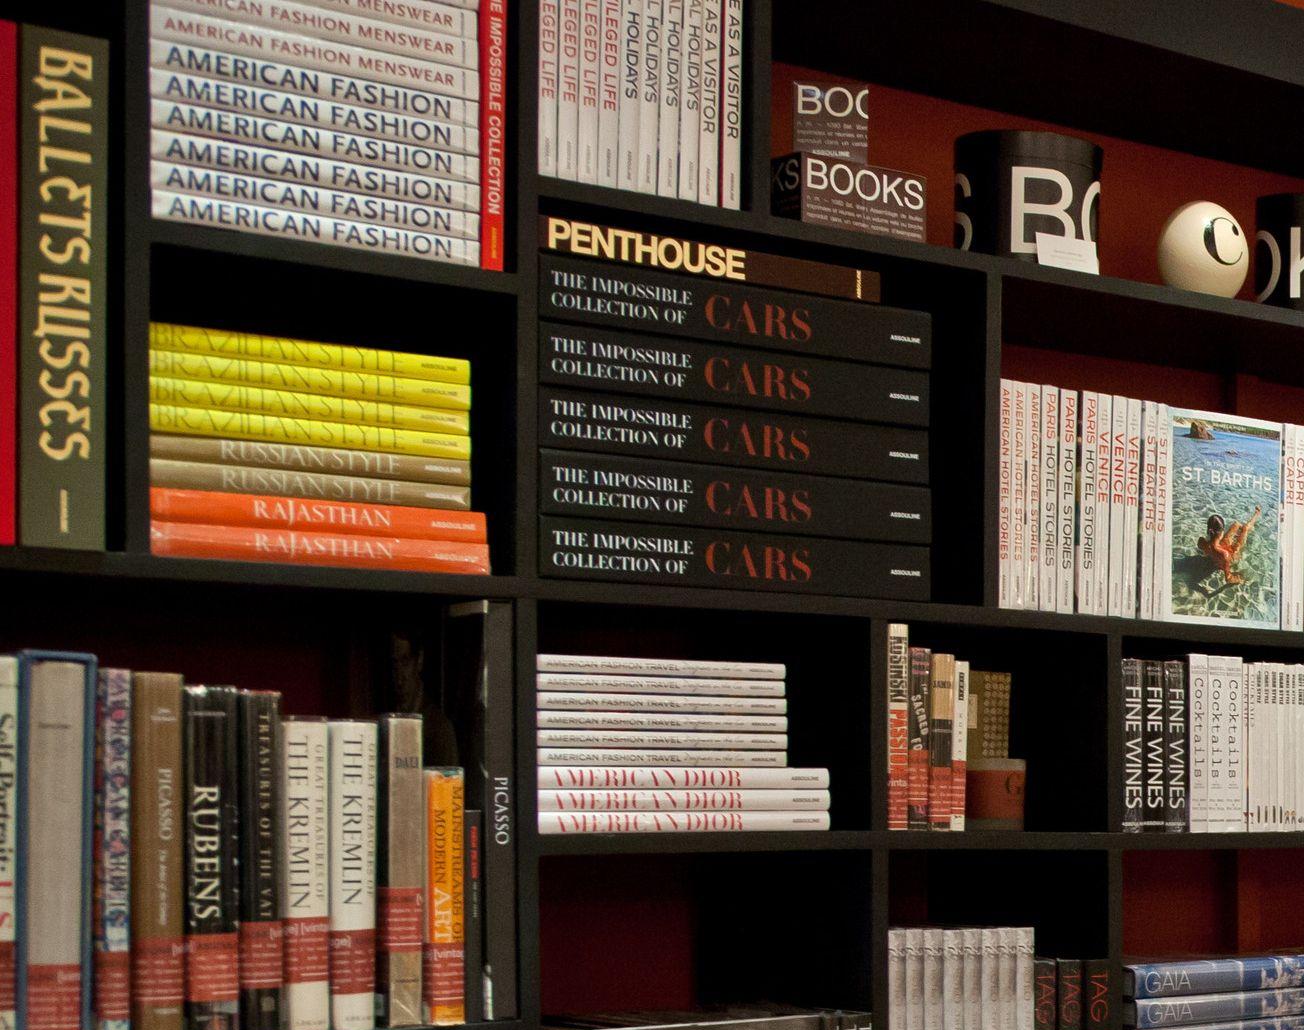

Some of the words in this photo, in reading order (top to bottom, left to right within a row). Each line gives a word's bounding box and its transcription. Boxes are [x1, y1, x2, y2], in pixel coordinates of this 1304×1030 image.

[164, 17, 263, 50] AMERICAN
[270, 38, 350, 66] FASHION
[358, 56, 455, 87] MENSWEAR
[728, 15, 741, 40] AS
[728, 45, 740, 58] A
[489, 15, 504, 111] IMPOSSIBLE
[624, 11, 640, 100] HOLIDAYS
[166, 46, 320, 95] AMERICAN
[331, 76, 452, 119] FASHION
[603, 73, 617, 112] LIFE
[726, 64, 741, 140] VISITOR
[34, 46, 93, 266] BALLETS
[487, 116, 502, 215] COLLECTION
[806, 157, 924, 211] BOOKS
[168, 196, 321, 239] AMERICAN
[548, 217, 747, 281] PENTHOUSE
[551, 270, 587, 292] THE
[592, 272, 693, 307] IMPOSSIBLE
[551, 291, 660, 322] COLLECTION
[664, 308, 687, 326] OF
[704, 293, 813, 343] CARS
[34, 272, 92, 463] RUSSES
[1001, 388, 1011, 456] AMERICAN
[1065, 396, 1075, 443] PARIS
[220, 439, 326, 470] RUSSIAN
[330, 451, 401, 475] STYLE
[1001, 460, 1010, 502] HOTEL
[1064, 448, 1074, 500] HOTEL
[1113, 432, 1125, 505] VENICE
[1182, 467, 1206, 484] ST.
[1210, 469, 1273, 492] BARTHS
[1295, 457, 1304, 507] CAPRI
[253, 499, 392, 528] RAJASTHAN
[1000, 506, 1010, 561] STORIES
[1062, 505, 1073, 570] STORIES
[911, 694, 929, 736] SACRED
[1147, 686, 1163, 732] FINE
[342, 734, 363, 785] THE
[547, 752, 599, 763] AMERICAN
[602, 753, 642, 764] FASHION
[645, 754, 681, 764] TRAVEL
[554, 768, 676, 788] AMERICAN
[684, 769, 742, 788] DIOR
[1147, 737, 1163, 808] WINES
[494, 776, 510, 845] PICASSO
[192, 785, 221, 921] RUBENS
[342, 794, 363, 906] KREMLIN
[433, 809, 446, 884] MODERN
[1090, 973, 1108, 1023] TAG
[1144, 970, 1191, 993] GAIA
